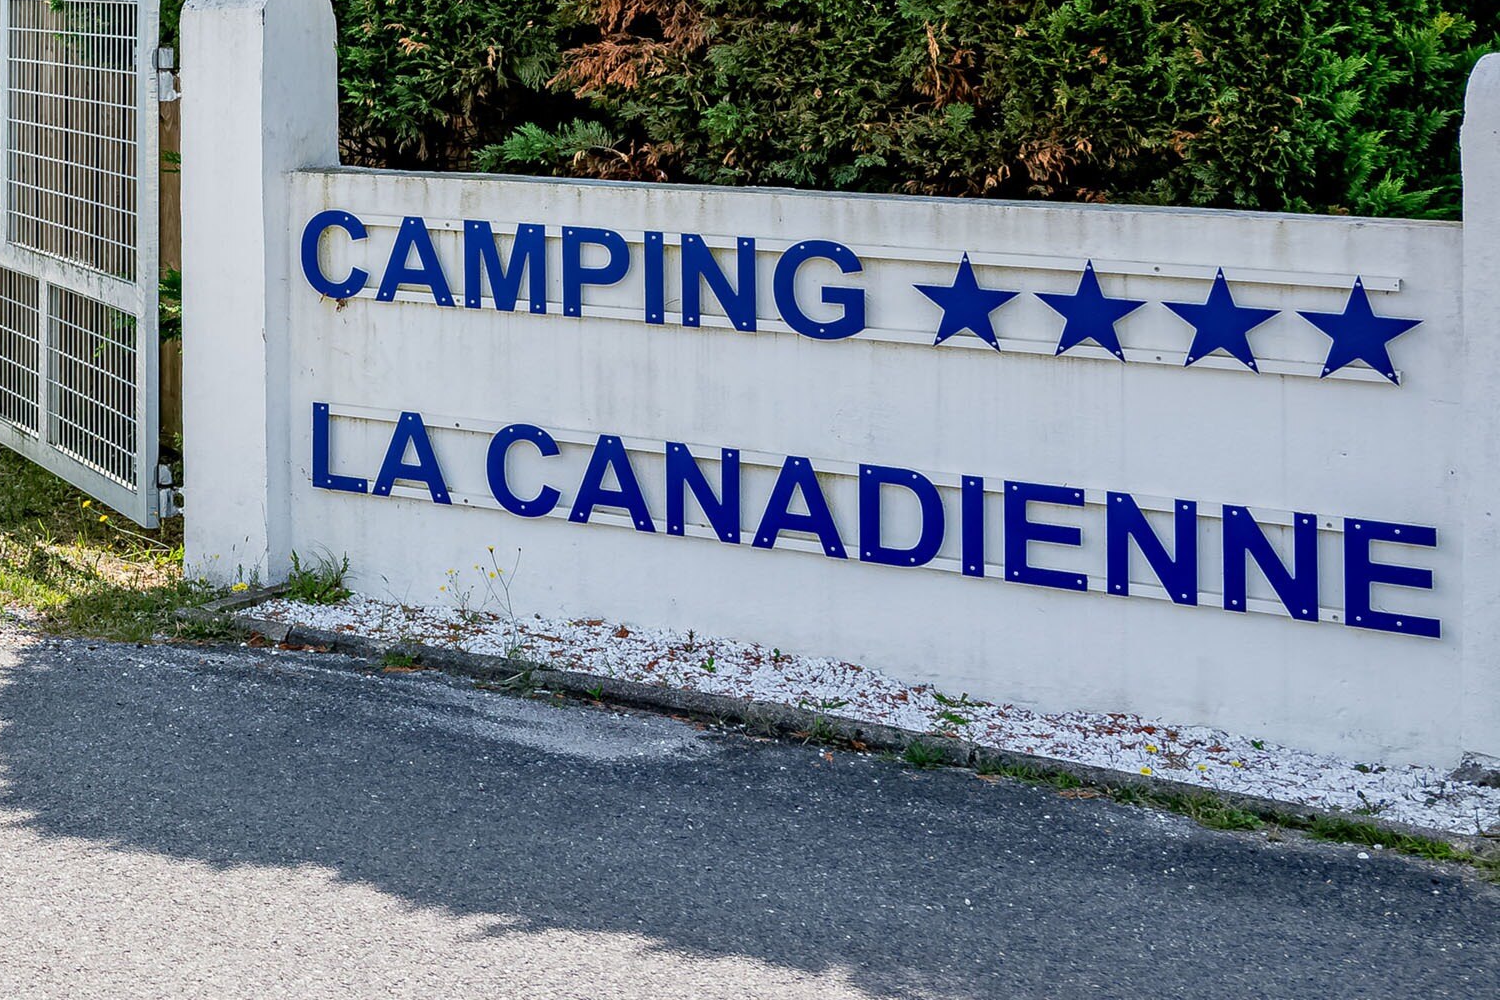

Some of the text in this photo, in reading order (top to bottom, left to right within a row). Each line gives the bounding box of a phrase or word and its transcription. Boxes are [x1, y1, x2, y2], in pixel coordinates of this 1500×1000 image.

[300, 209, 866, 340] CAMPING
[312, 401, 1442, 639] LA CANADIENNE
